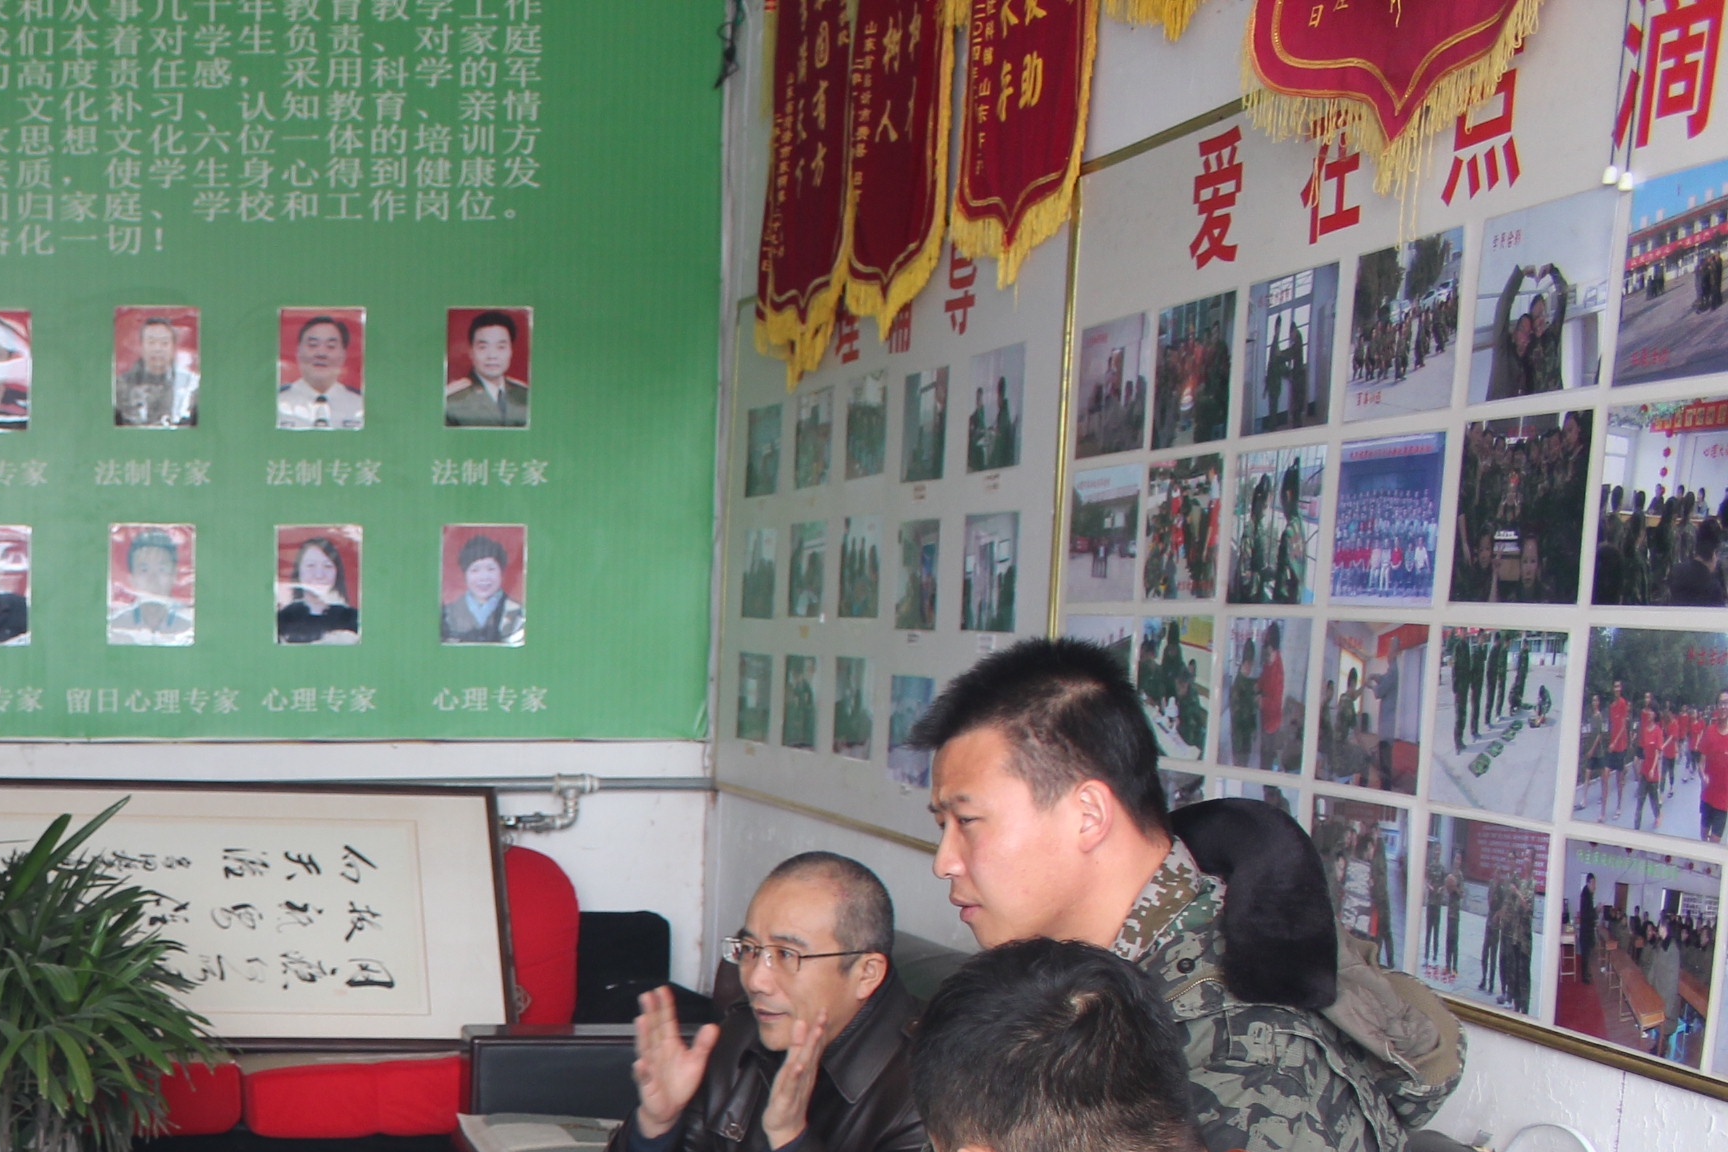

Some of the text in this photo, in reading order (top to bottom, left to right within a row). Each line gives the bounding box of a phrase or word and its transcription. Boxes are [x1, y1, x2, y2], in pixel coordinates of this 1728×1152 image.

[94, 458, 212, 487] 法制专家
[265, 458, 382, 487] 法制专家
[430, 458, 548, 487] 法制专家
[66, 688, 240, 715] 留日心理专家
[260, 686, 376, 713] 心理专家
[432, 686, 548, 713] 心理专家
